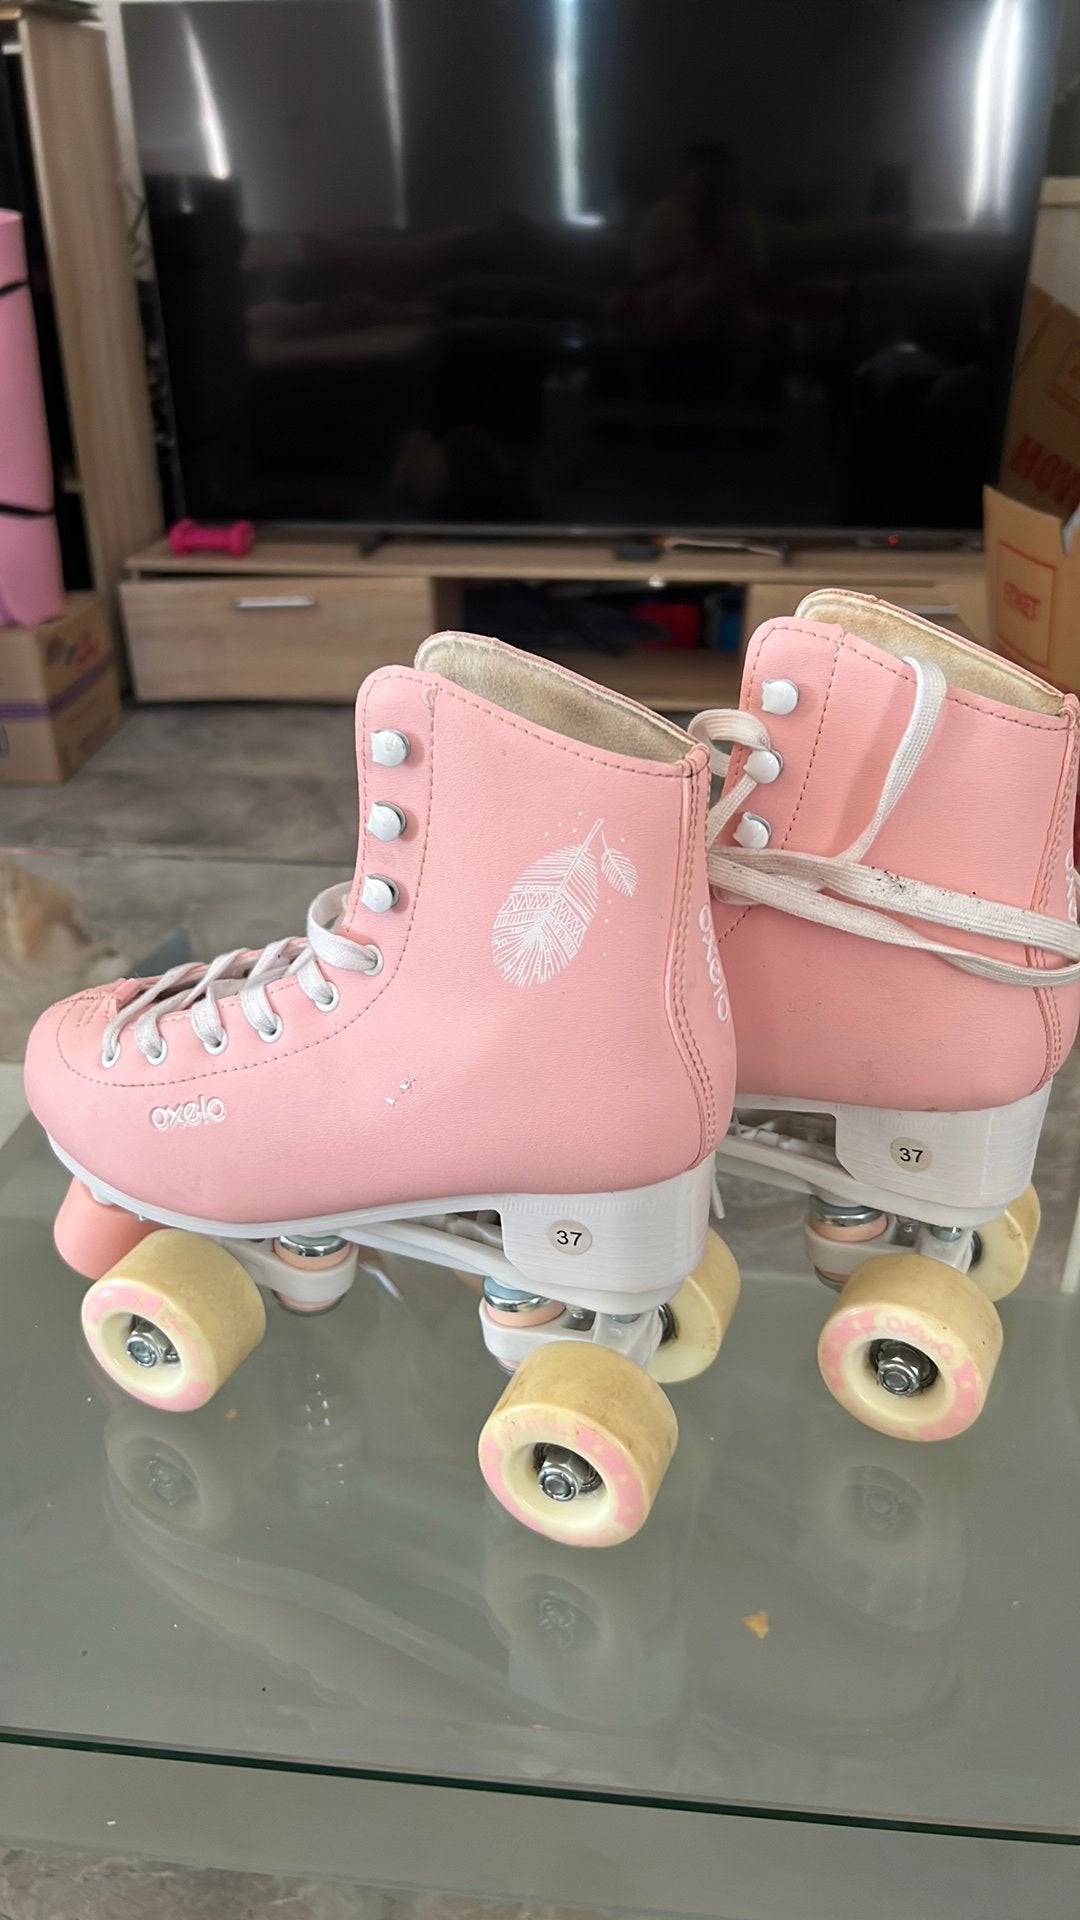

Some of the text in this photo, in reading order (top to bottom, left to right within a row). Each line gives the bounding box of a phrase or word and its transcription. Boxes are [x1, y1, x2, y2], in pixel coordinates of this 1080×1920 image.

[150, 1095, 227, 1131] oxelo
[899, 1147, 923, 1163] 37
[556, 1229, 583, 1246] 37
